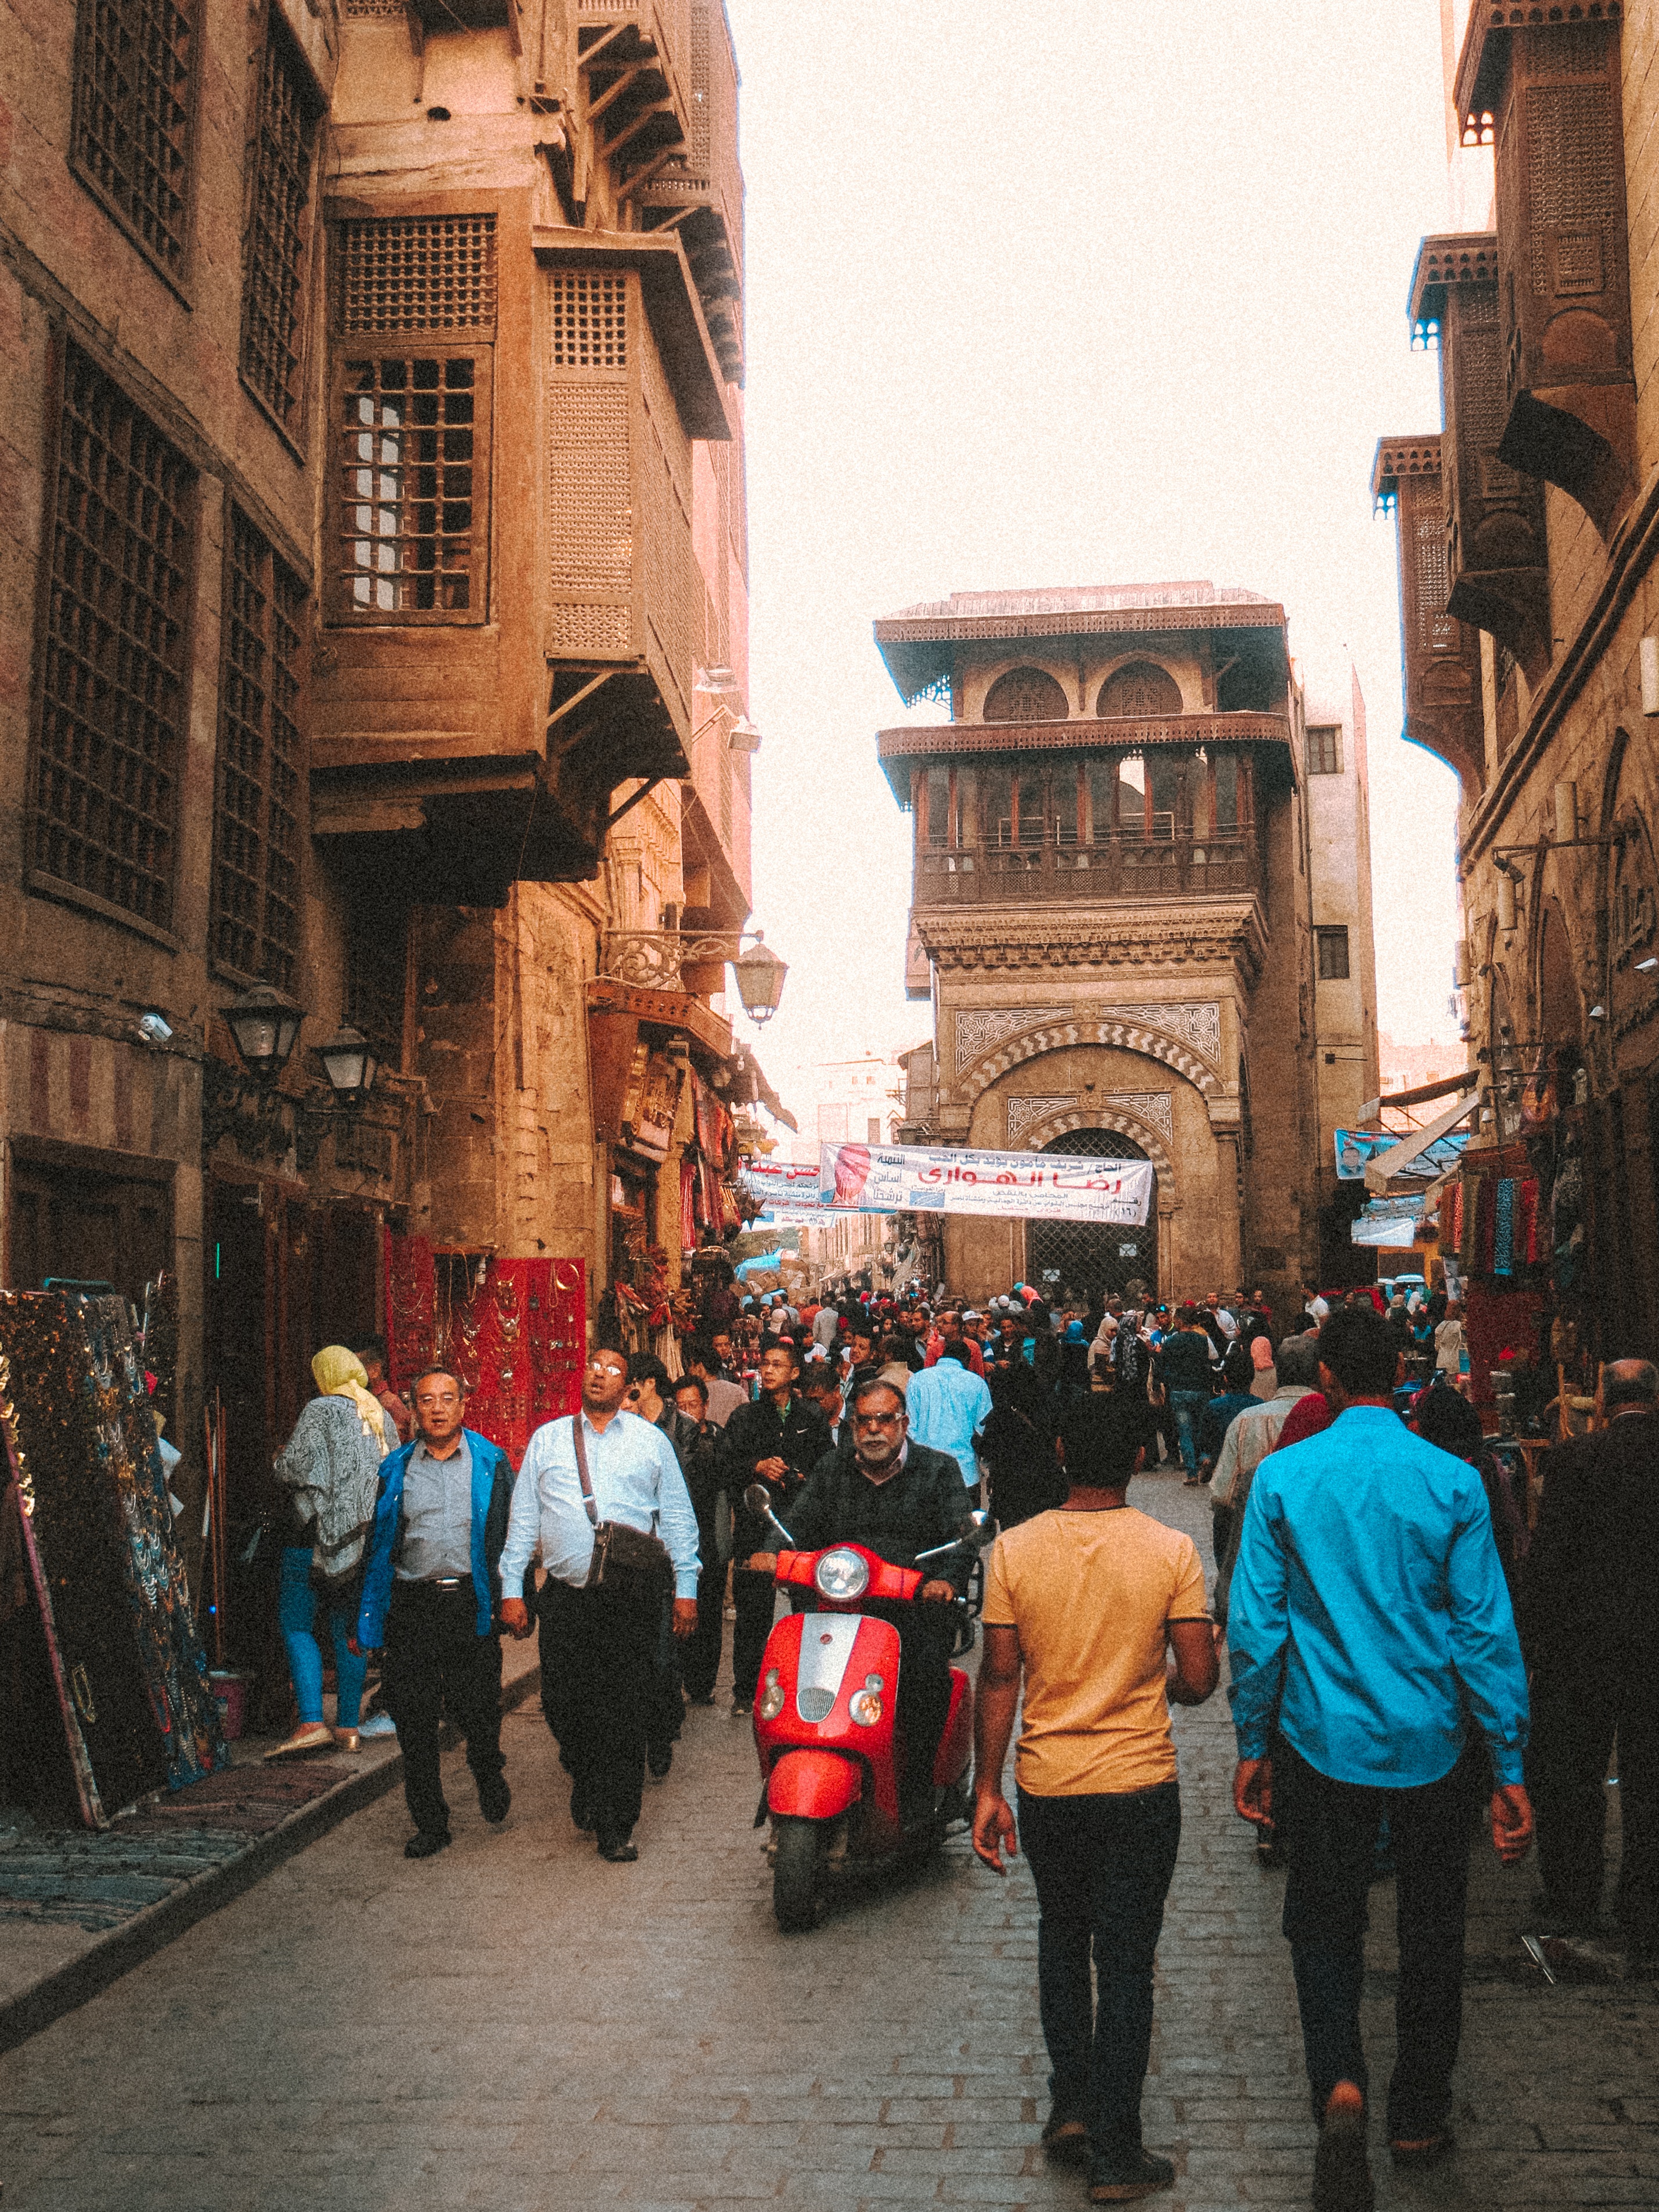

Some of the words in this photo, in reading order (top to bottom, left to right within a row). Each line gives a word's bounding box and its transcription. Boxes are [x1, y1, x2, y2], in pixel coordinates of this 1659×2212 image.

[929, 1153, 957, 1164] الحب
[960, 1154, 980, 1166] بكل
[1050, 1160, 1084, 1172] شريف
[1053, 1172, 1122, 1195] رضا
